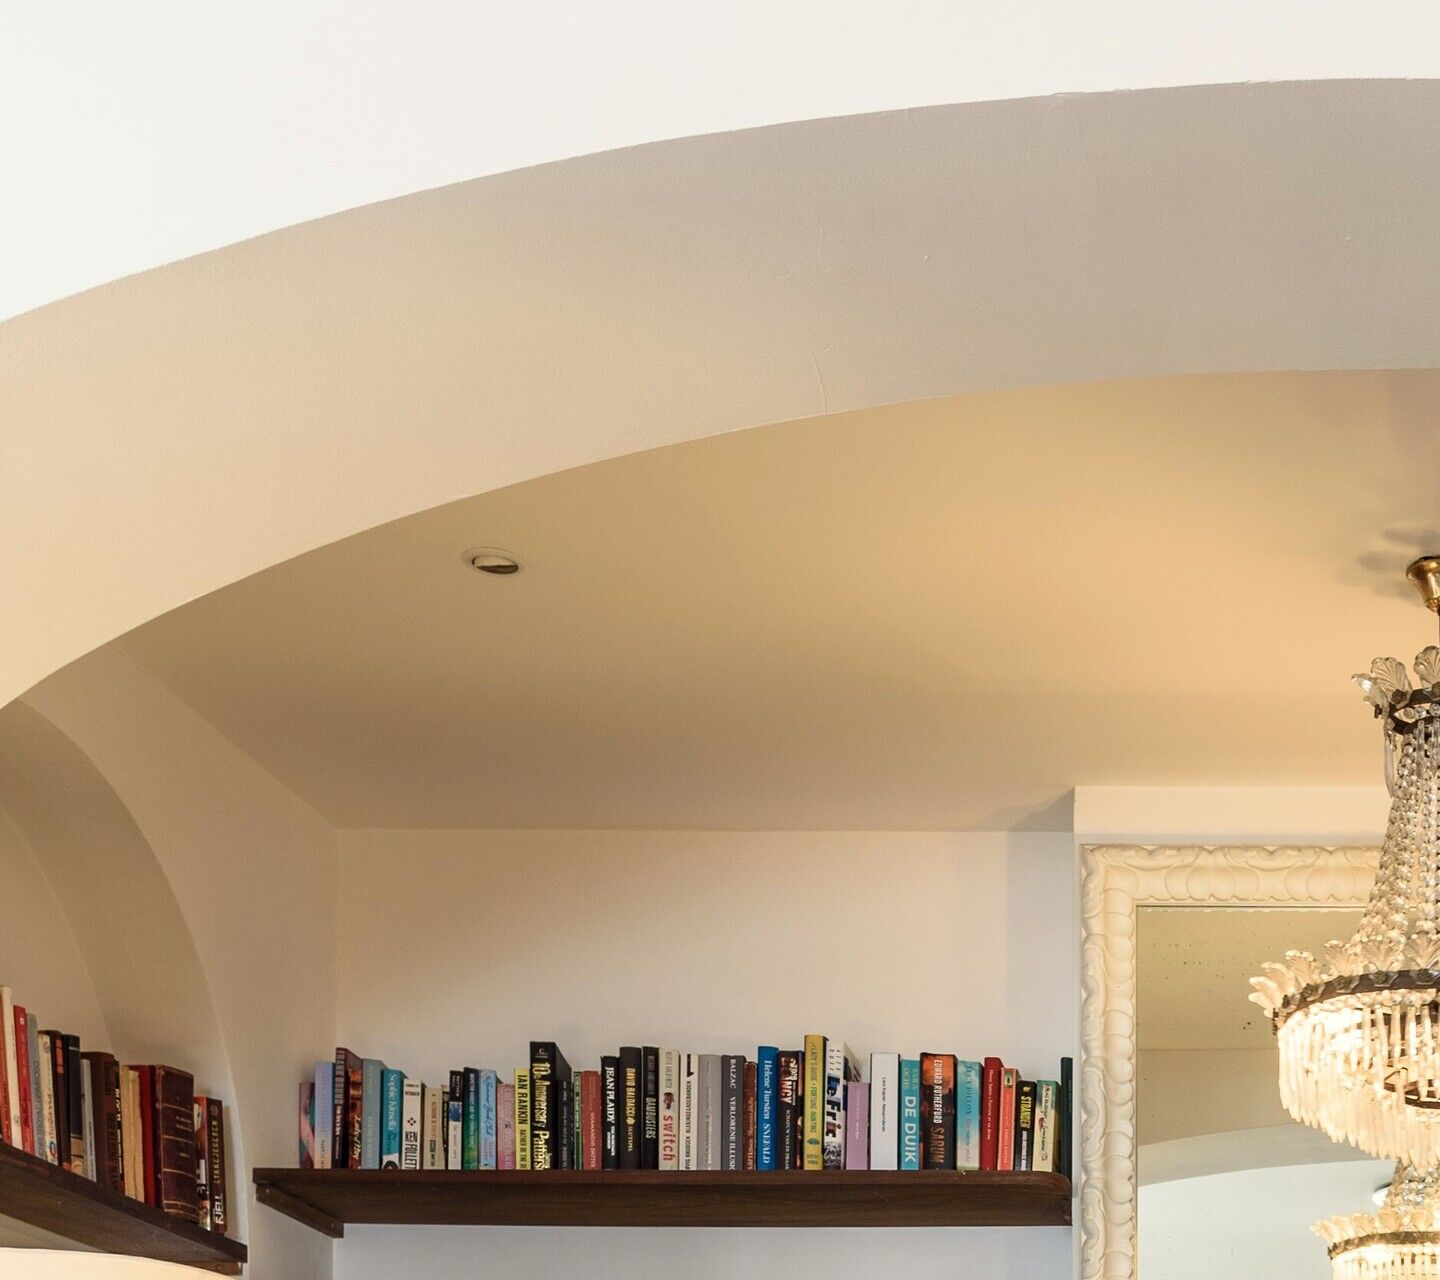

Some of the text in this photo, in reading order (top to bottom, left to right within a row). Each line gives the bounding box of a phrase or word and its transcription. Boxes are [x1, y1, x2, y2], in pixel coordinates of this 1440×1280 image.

[335, 1050, 345, 1104] FRANK BRUNO
[518, 1075, 528, 1089] IAN
[605, 1067, 614, 1123] JEAN PLAIDY
[626, 1068, 635, 1116] DAVID BALDACCI
[764, 1060, 772, 1088] Helene
[387, 1074, 398, 1130] Sophie Kinsella
[518, 1093, 528, 1124] RANKIN
[764, 1089, 772, 1119] Tursten
[826, 1076, 841, 1138] Le Fric
[930, 1060, 944, 1163] EDWARD SARUM
[405, 1131, 418, 1143] KEN
[663, 1115, 671, 1161] switch
[905, 1096, 916, 1162] DE DUIK
